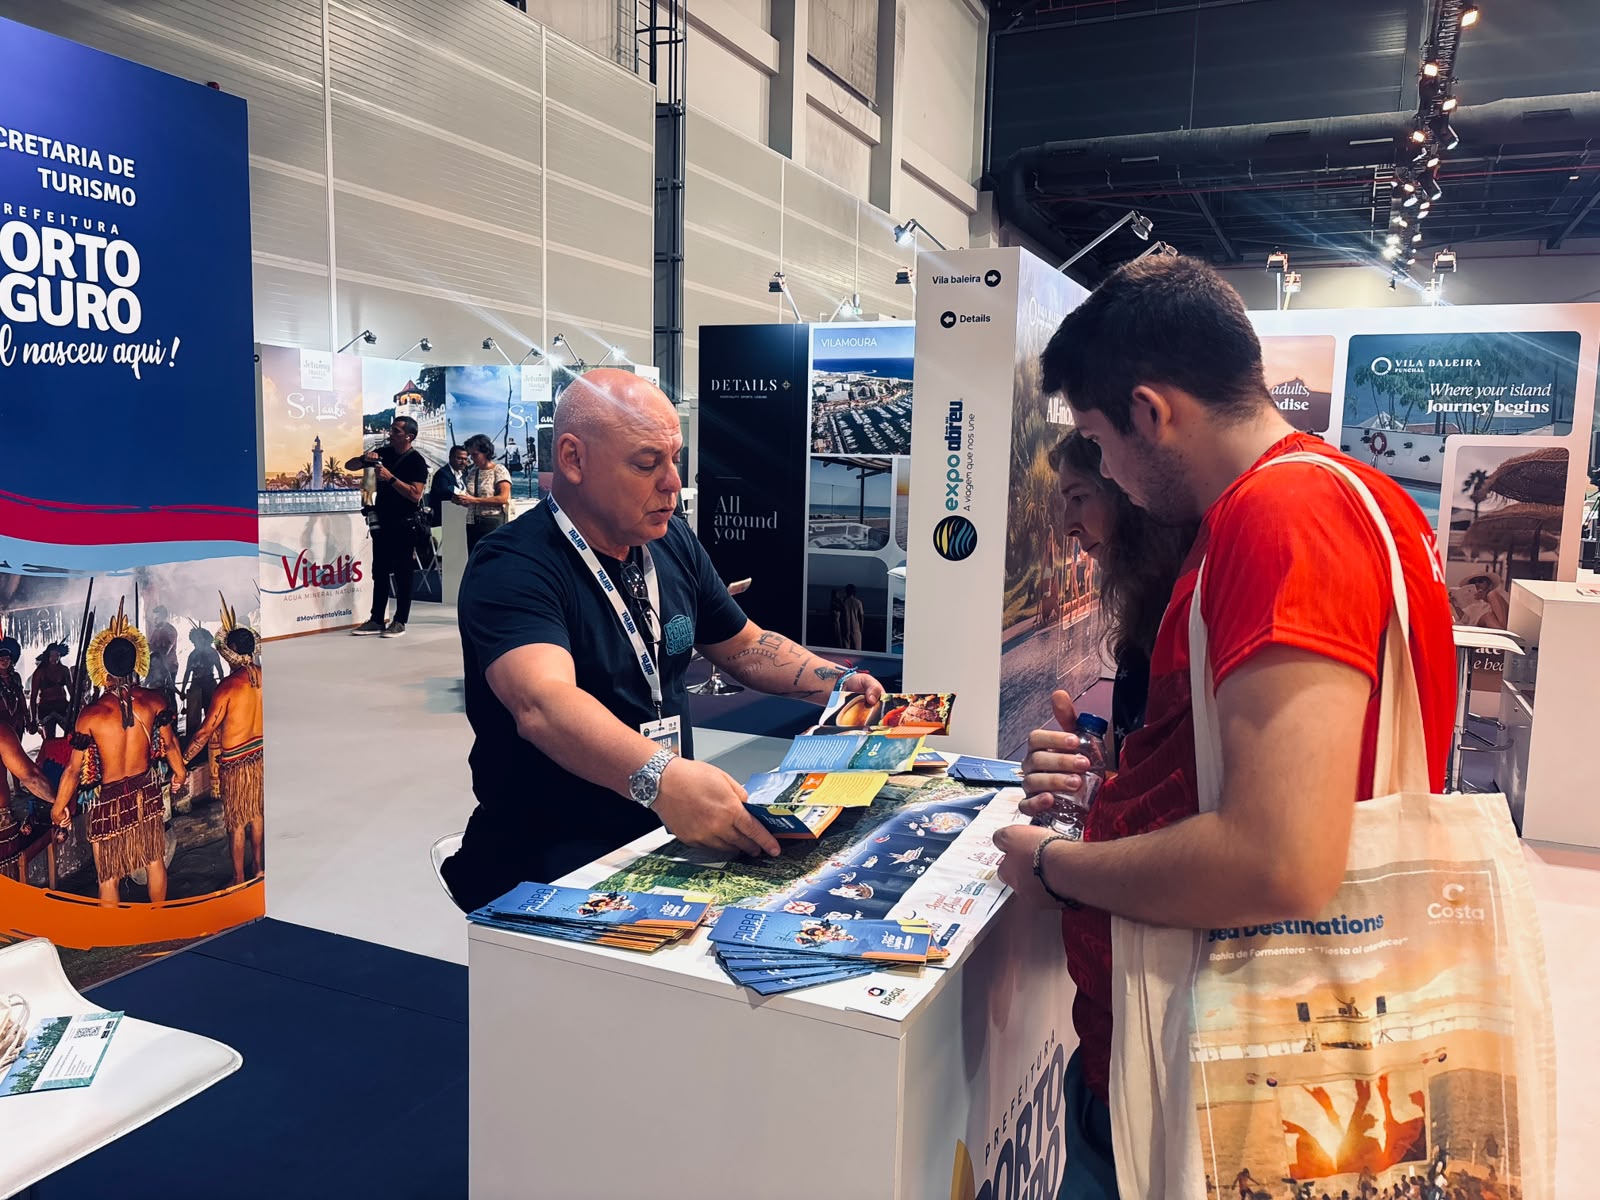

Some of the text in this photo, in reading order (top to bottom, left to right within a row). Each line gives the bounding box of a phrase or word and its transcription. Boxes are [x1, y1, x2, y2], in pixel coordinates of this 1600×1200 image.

[108, 154, 136, 178] DE
[37, 167, 136, 207] TURISMO
[0, 220, 141, 288] ORTO
[932, 274, 981, 284] Vila baleira
[0, 272, 142, 334] GURO
[960, 314, 991, 323] Details
[821, 337, 878, 348] VILAMOURA
[23, 340, 108, 368] nasceu
[1395, 358, 1482, 368] VILA BALEIRA
[711, 378, 777, 391] DETAILS
[1271, 382, 1310, 397] adults,
[1430, 382, 1552, 400] Where your island
[287, 392, 347, 422] Sri Lanka
[508, 404, 533, 429] Sri
[1425, 400, 1550, 416] Journey begins
[968, 413, 976, 432] une
[944, 401, 964, 511] expo abreu
[966, 451, 974, 471] que
[965, 471, 974, 503] viagem
[714, 495, 740, 513] All
[963, 504, 971, 512] A
[714, 510, 778, 529] around
[714, 527, 746, 545] you
[281, 548, 363, 589] Vitalis
[1427, 902, 1485, 921] Costa
[1243, 914, 1384, 938] Destinations
[984, 1028, 1056, 1167] PREFEITURA
